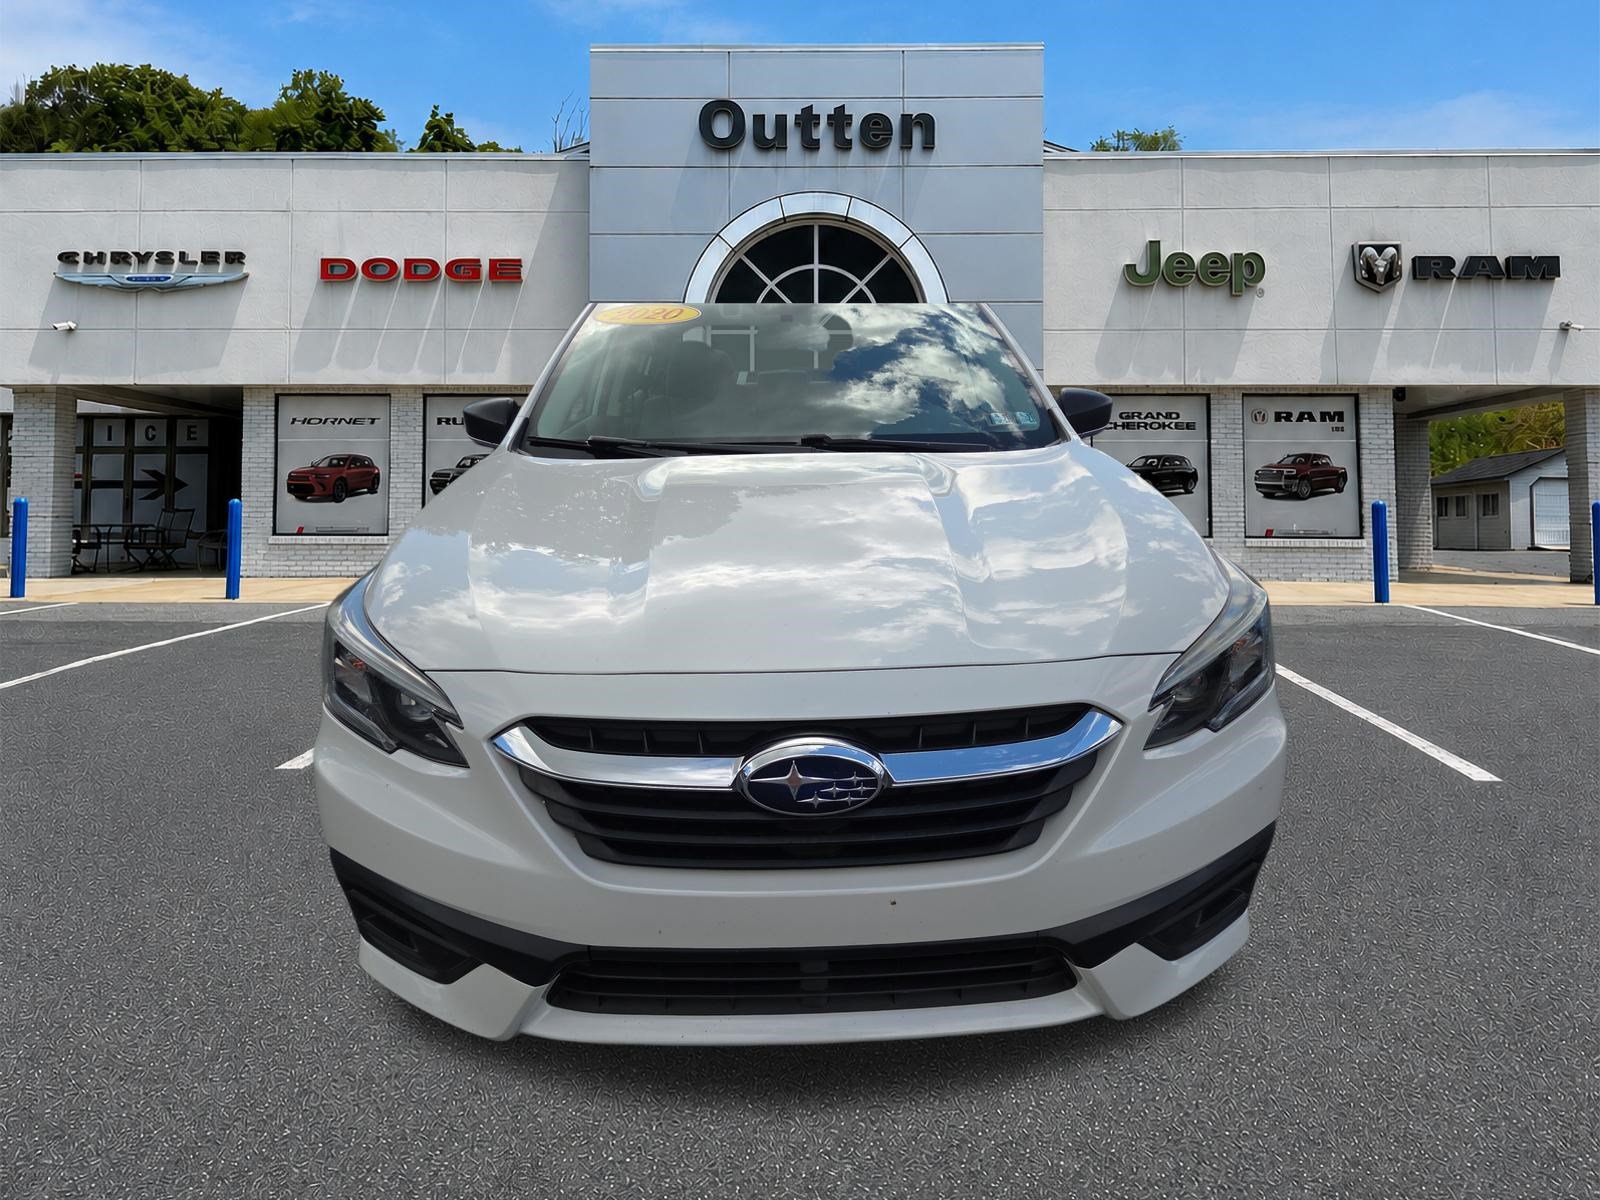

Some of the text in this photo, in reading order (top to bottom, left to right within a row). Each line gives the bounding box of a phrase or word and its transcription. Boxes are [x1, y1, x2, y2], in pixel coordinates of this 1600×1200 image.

[698, 99, 936, 150] Outten
[57, 250, 247, 266] CHRYSLER
[1123, 240, 1266, 296] Jeep
[1411, 256, 1561, 280] RAM
[320, 257, 523, 282] DODGE
[290, 417, 380, 426] HORNET
[1118, 411, 1181, 420] GRAND
[1274, 411, 1345, 423] RAM
